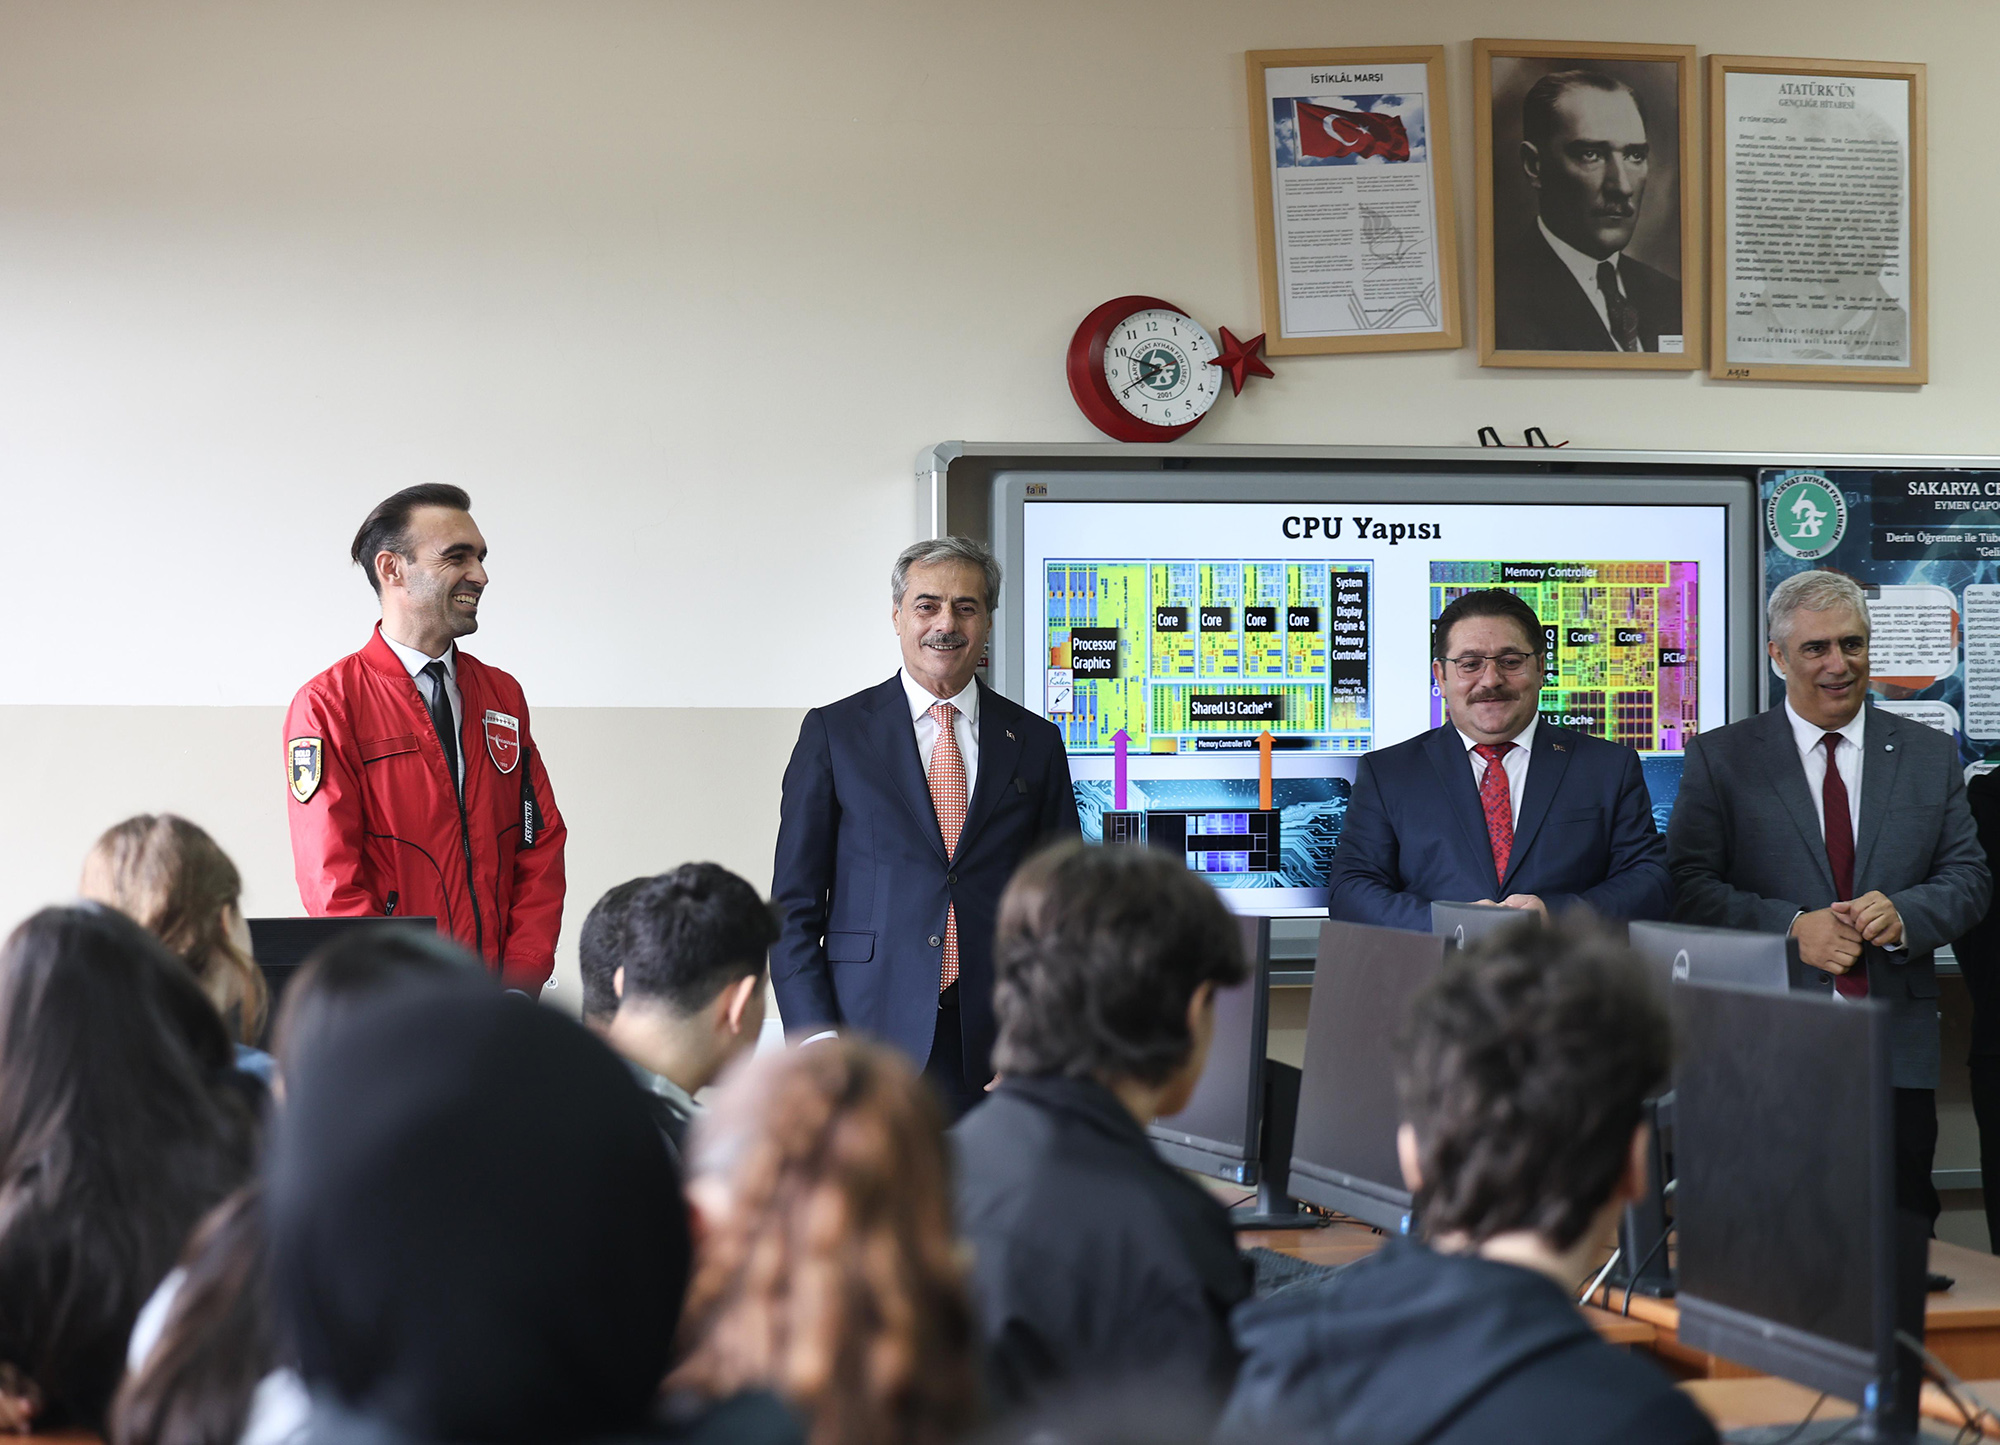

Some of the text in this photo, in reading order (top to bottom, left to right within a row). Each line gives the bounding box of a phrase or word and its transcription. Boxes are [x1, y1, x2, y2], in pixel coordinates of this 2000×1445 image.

[1310, 72, 1384, 84] İSTİKLÂL MARŞI
[1778, 82, 1856, 97] ATATÜRK'ÜN
[1146, 321, 1158, 332] 12
[1172, 326, 1178, 336] 1
[1126, 330, 1137, 340] 11
[1114, 347, 1127, 357] 10
[1191, 341, 1198, 351] 2
[1135, 342, 1151, 358] CEVAT
[1153, 342, 1175, 352] AYHAN
[1174, 351, 1184, 363] FEN
[1201, 361, 1208, 370] 3
[1112, 369, 1118, 378] 9
[1197, 382, 1204, 392] 4
[1123, 389, 1130, 399] 8
[1142, 404, 1148, 414] 7
[1185, 400, 1192, 410] 5
[1165, 408, 1171, 418] 6
[1908, 482, 1981, 496] SAKARYA
[1769, 497, 1779, 538] SAKARYA
[1776, 477, 1800, 495] CEVAT
[1802, 476, 1830, 490] AYHAN
[1829, 489, 1841, 506] FEN
[1935, 501, 2000, 512] EYMEN ÇAPO
[1282, 516, 1442, 545] CPU Yapısı
[1886, 533, 1915, 542] Derin
[1916, 531, 1963, 545] Öğrenme
[1964, 533, 1977, 542] ile
[1505, 567, 1598, 579] Memory Controller
[1336, 577, 1363, 590] System
[1338, 592, 1362, 604] Agent,
[1336, 606, 1362, 619] Display
[1157, 613, 1178, 626] Core
[1201, 613, 1222, 626] Core
[1246, 613, 1267, 627] Core
[1289, 613, 1310, 627] Core
[1334, 621, 1366, 634] Engine &
[1335, 636, 1364, 648] Memory
[1571, 632, 1594, 642] Core
[1618, 632, 1642, 642] Core
[1072, 637, 1117, 650] Processor
[1332, 650, 1367, 660] Controller
[1663, 653, 1686, 663] PCIe
[1072, 656, 1111, 672] Graphics
[1192, 701, 1223, 714] Shared
[1224, 702, 1236, 714] L3
[1547, 715, 1594, 725] L3 Cache
[1198, 740, 1218, 749] Memory
